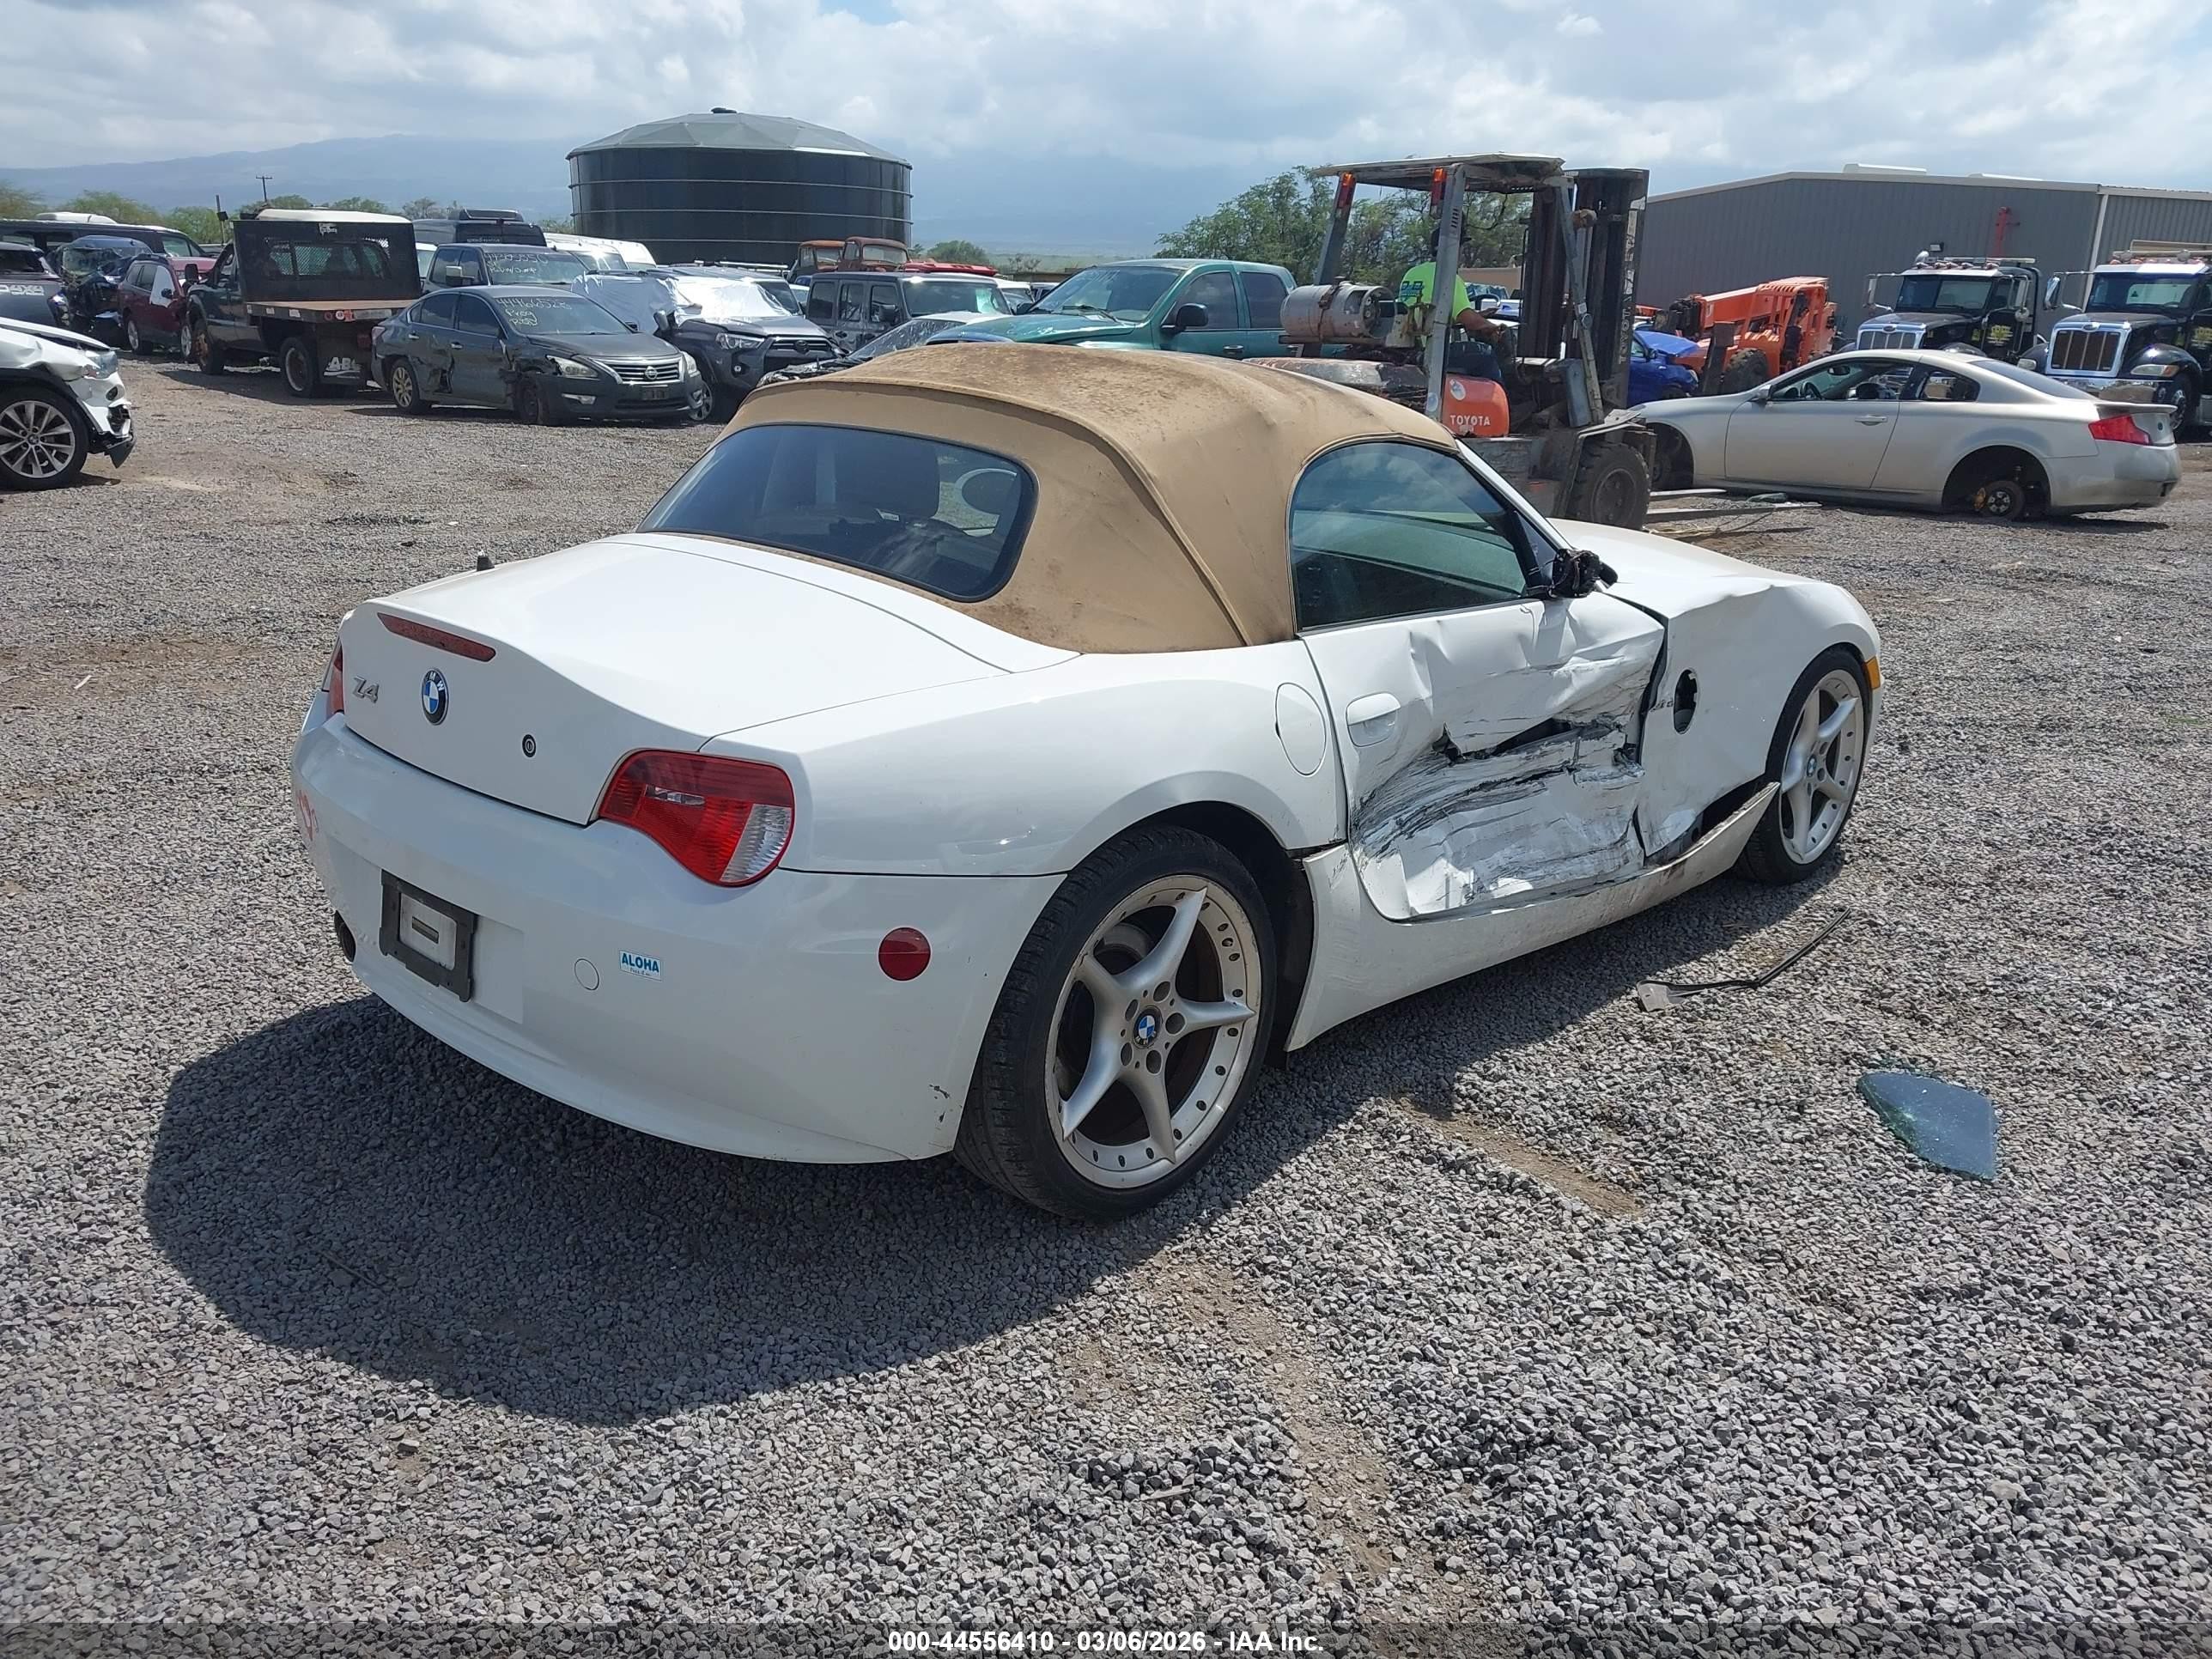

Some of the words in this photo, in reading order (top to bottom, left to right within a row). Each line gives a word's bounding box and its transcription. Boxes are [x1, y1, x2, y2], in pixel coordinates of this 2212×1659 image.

[1618, 306, 1632, 365] TOYOT
[1449, 415, 1491, 427] TOYOTA
[352, 676, 380, 704] Z4
[622, 952, 659, 973] ALOHA
